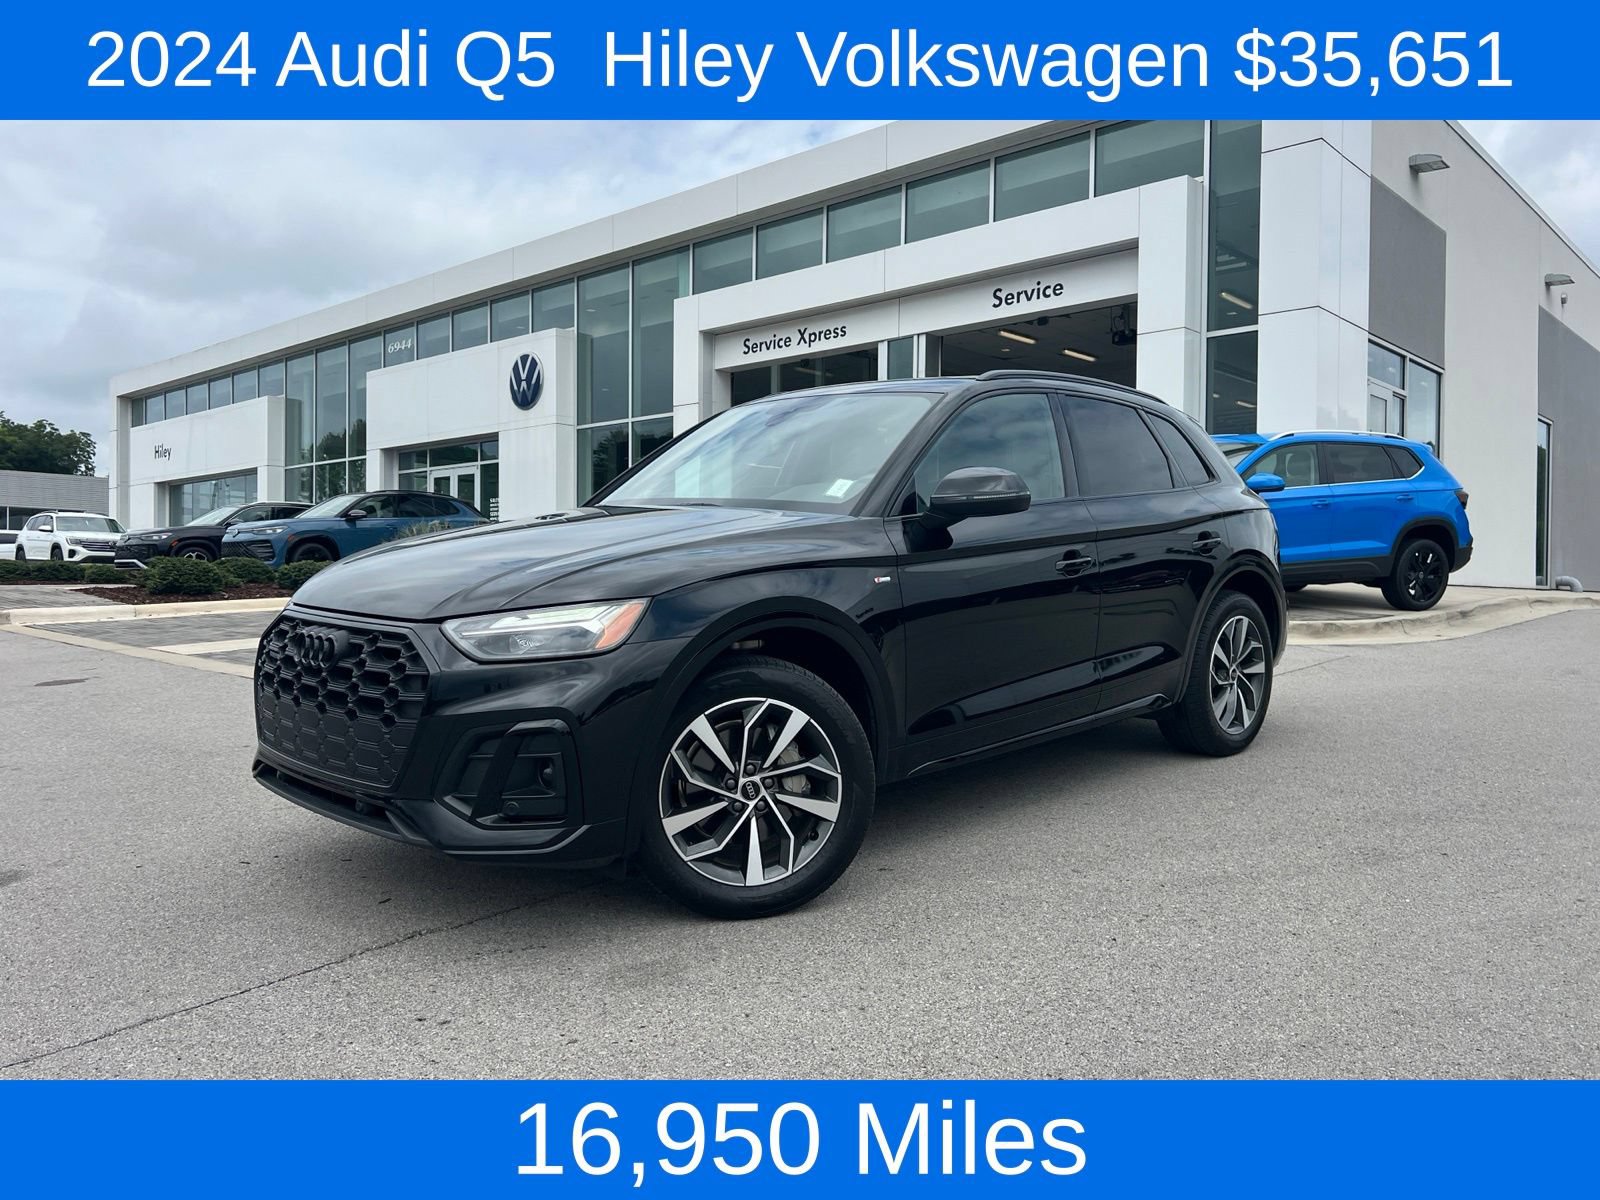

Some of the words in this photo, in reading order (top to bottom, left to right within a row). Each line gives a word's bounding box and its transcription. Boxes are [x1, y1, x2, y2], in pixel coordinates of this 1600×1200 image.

[992, 281, 1064, 308] Service
[388, 338, 412, 353] 6944
[743, 334, 792, 355] Service
[797, 326, 847, 348] Xpress
[154, 443, 172, 461] Hiley
